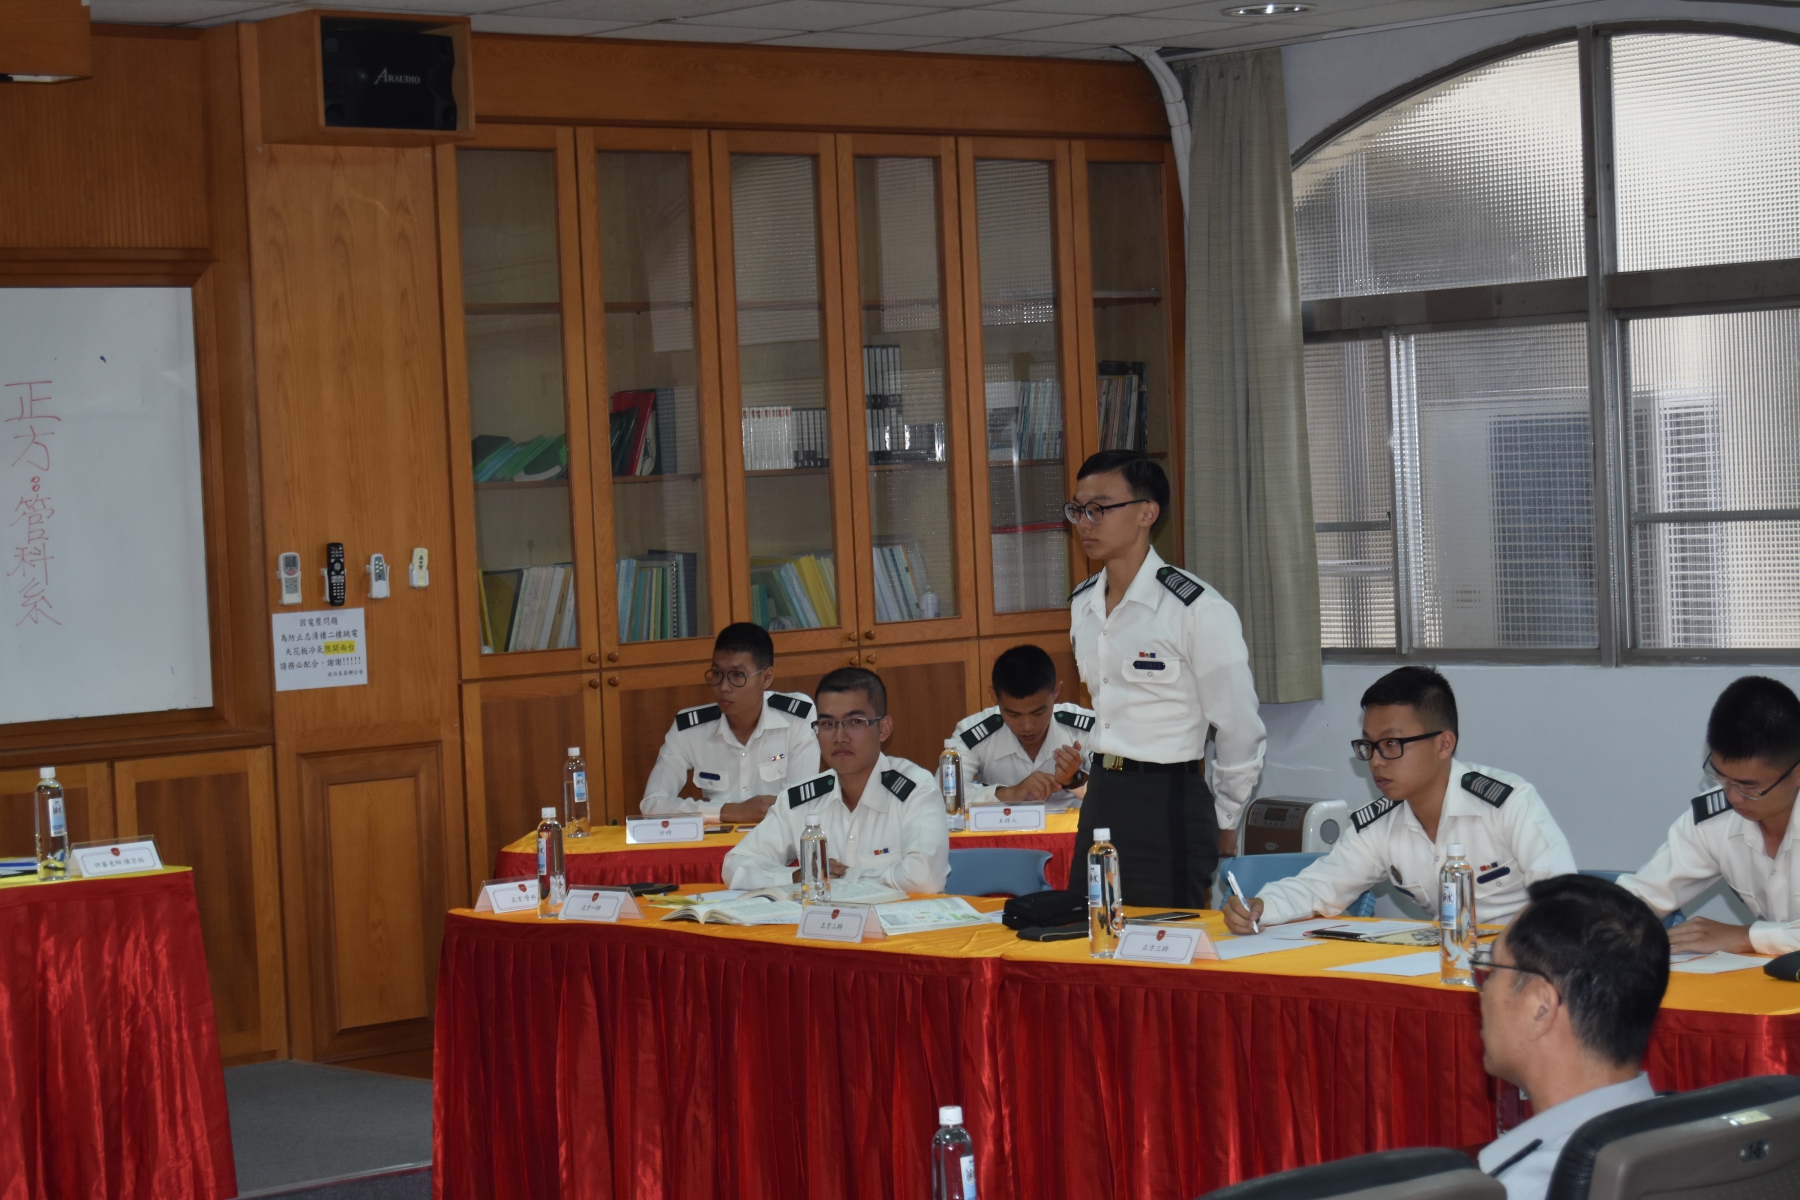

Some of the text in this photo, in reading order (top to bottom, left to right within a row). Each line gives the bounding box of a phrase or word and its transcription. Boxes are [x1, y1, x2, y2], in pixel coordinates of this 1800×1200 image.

[373, 67, 421, 85] ARAUDIO
[4, 380, 62, 627] 正方：管科系
[299, 616, 339, 627] 因電壓問題
